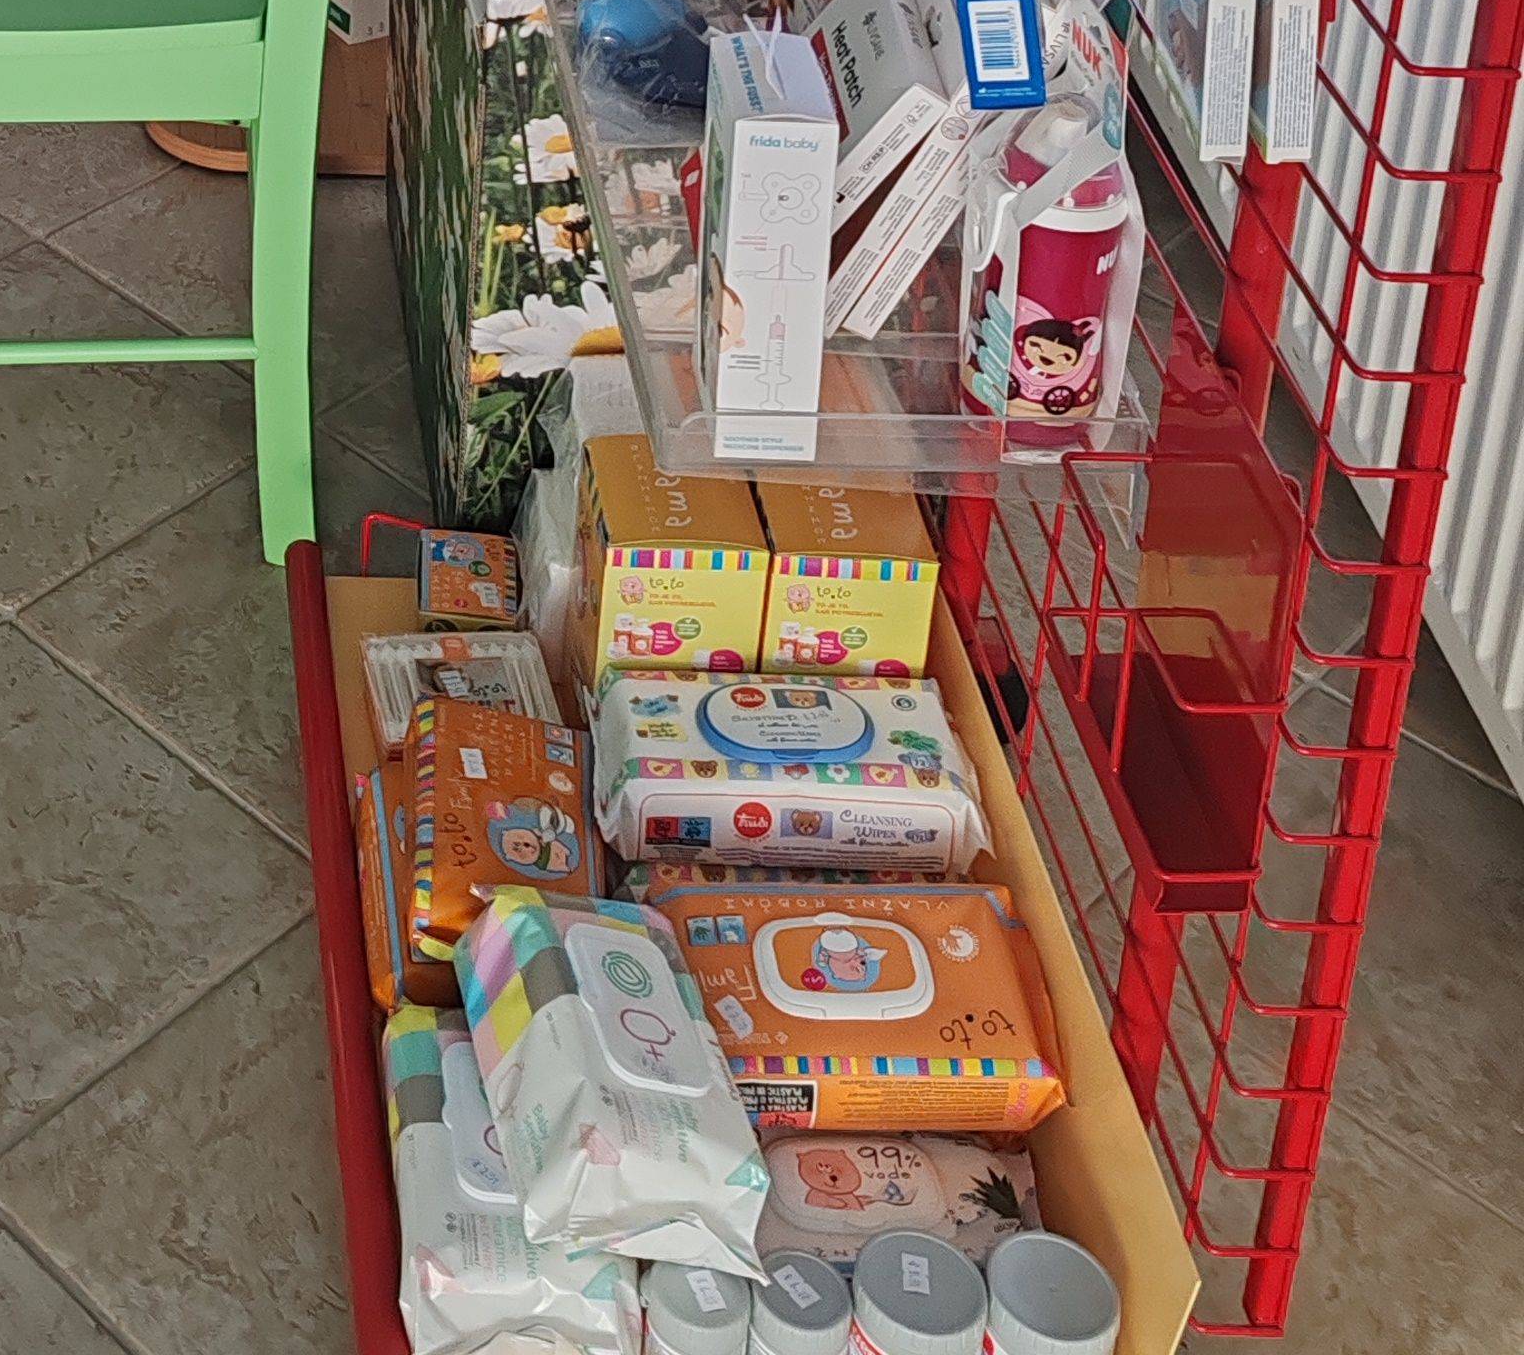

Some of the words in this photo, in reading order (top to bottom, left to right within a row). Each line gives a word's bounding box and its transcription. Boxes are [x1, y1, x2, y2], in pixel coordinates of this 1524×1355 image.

[731, 36, 747, 65] WHAT'S
[831, 20, 849, 59] Heat
[844, 59, 866, 109] Patch
[749, 134, 781, 148] frida
[783, 136, 819, 152] baby
[649, 577, 685, 590] to.to
[816, 585, 852, 599] to.to
[736, 812, 769, 831] Trudi
[839, 809, 914, 828] CLEANSING
[439, 811, 466, 869] to.to
[854, 826, 897, 840] WIPES
[723, 897, 826, 911] ROBČKI
[847, 898, 949, 912] VLAŽNI
[939, 1009, 1018, 1050] to.to
[857, 1145, 922, 1169] 99%
